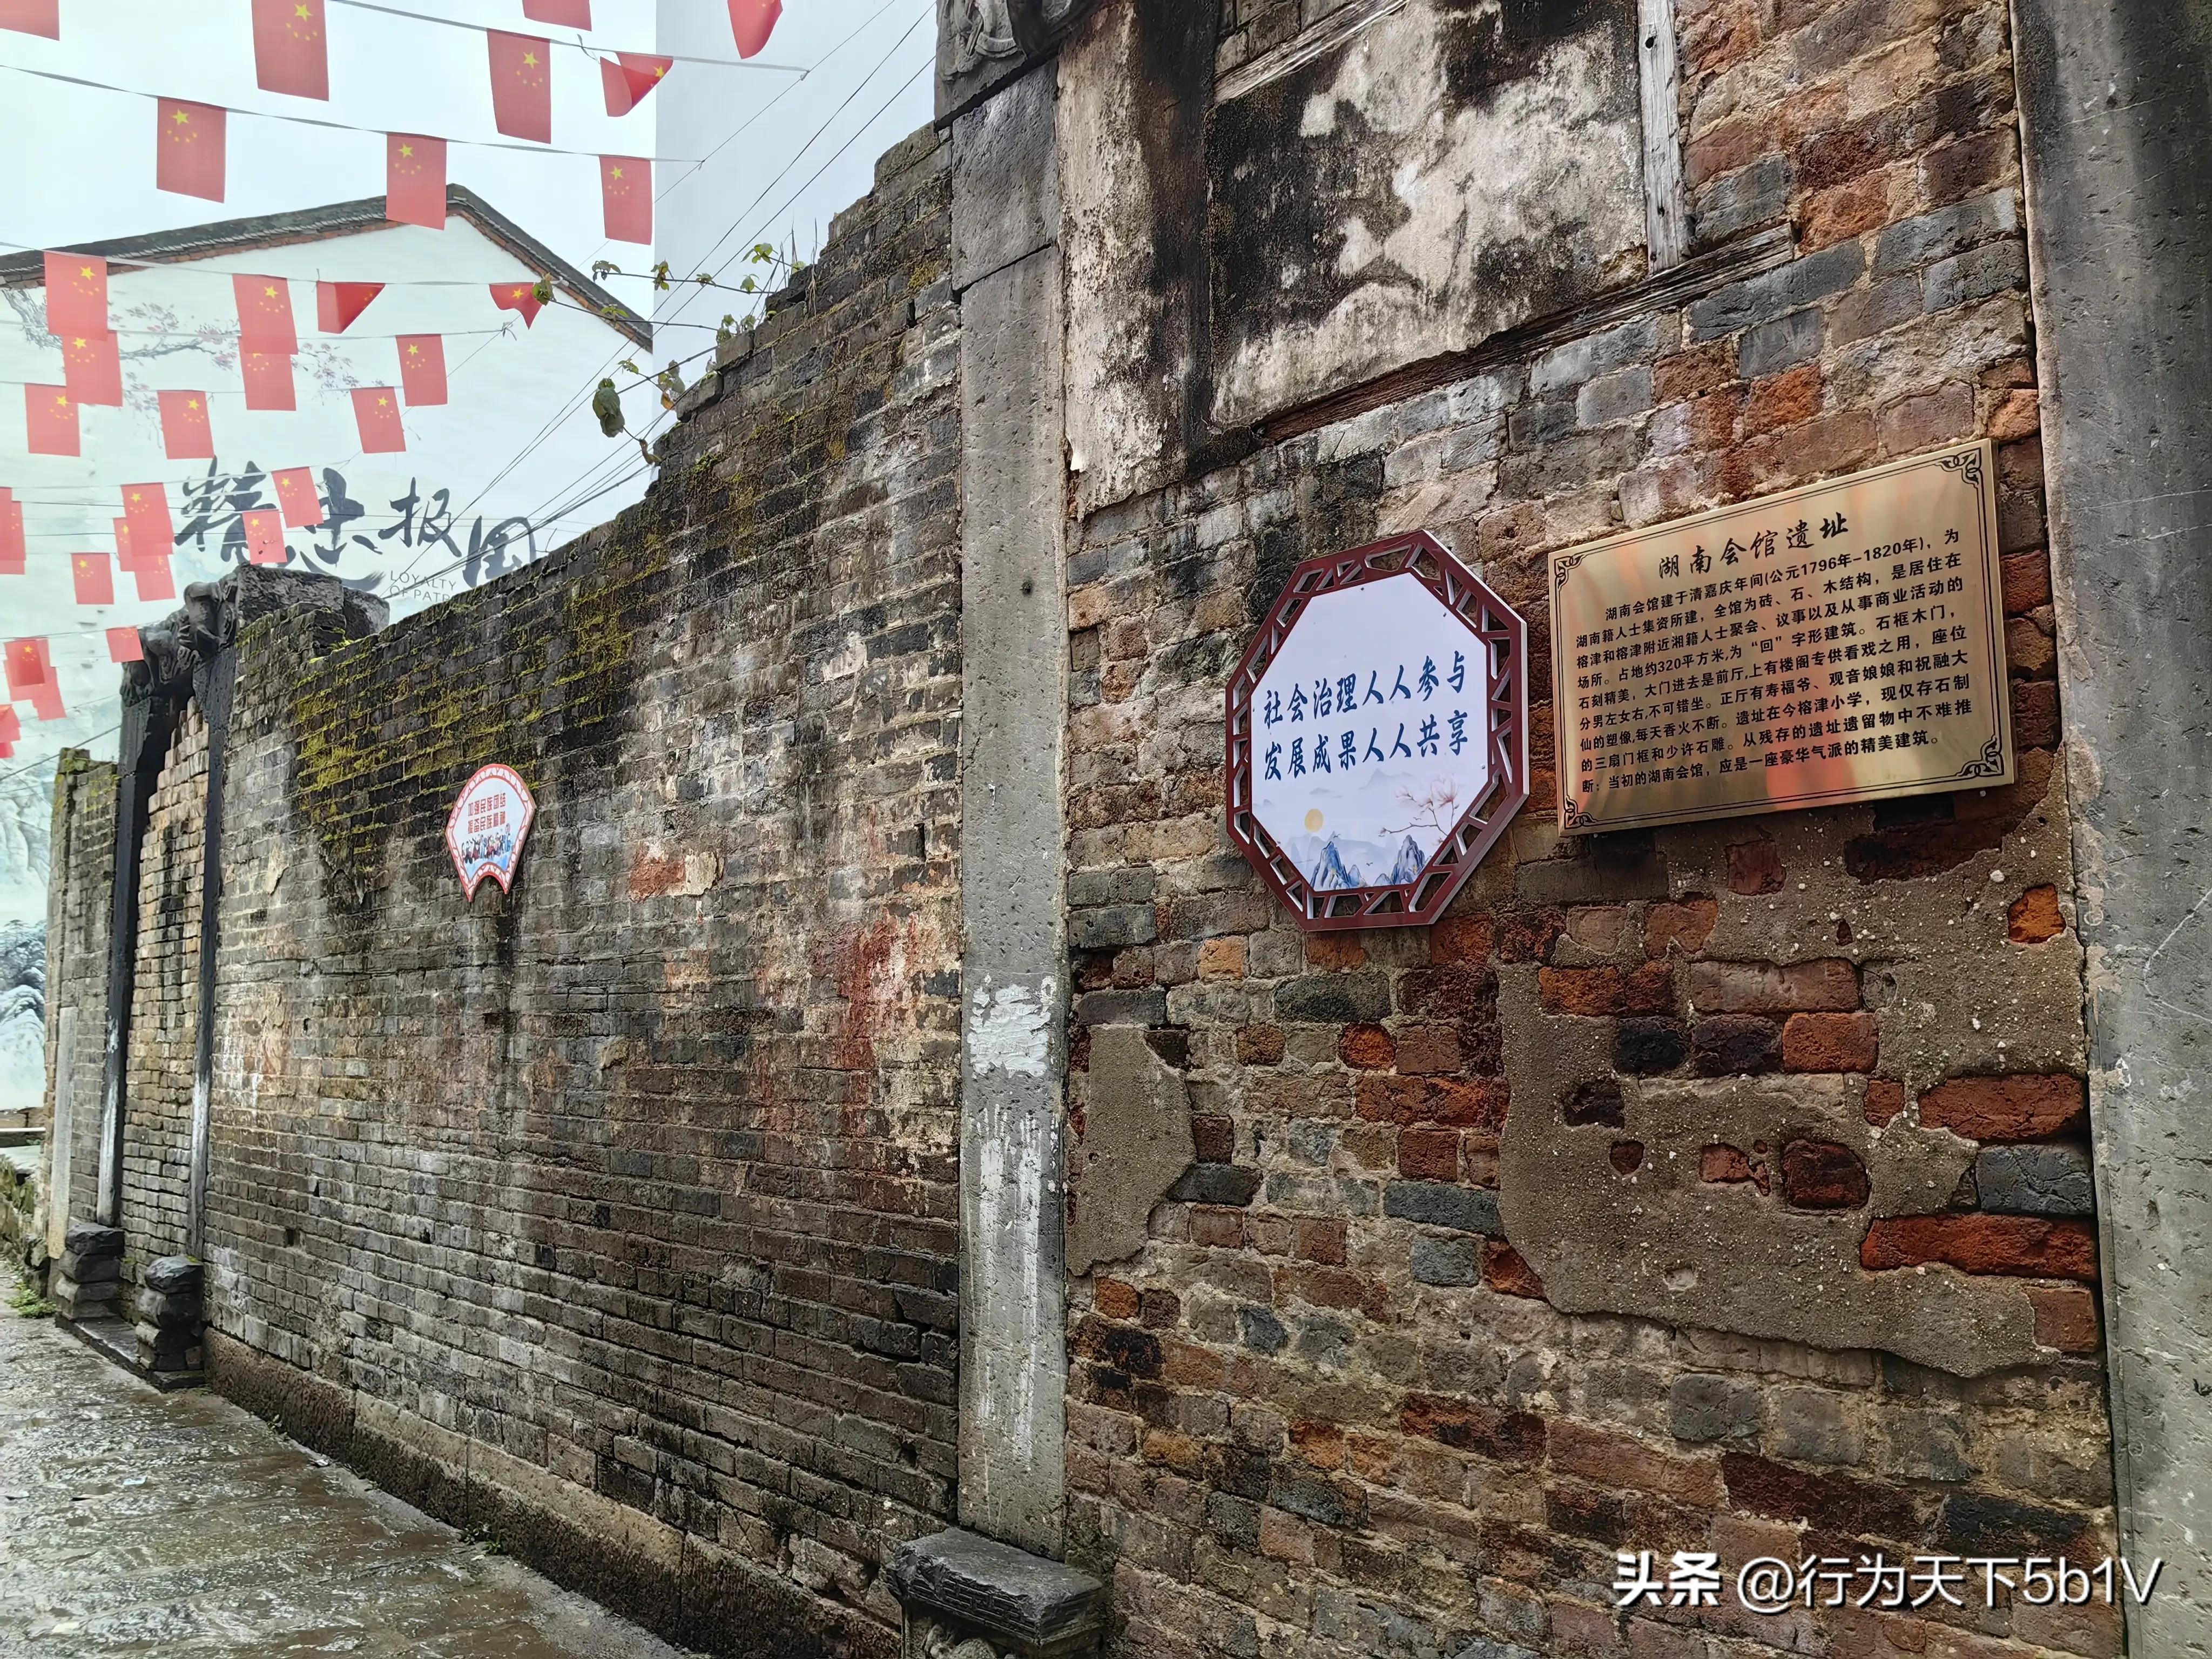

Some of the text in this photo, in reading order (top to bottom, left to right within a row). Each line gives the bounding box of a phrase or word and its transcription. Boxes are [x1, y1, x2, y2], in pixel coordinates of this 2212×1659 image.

[1658, 511, 1849, 579] 湖南会馆遗址
[390, 570, 456, 591] LOYALTY
[390, 585, 408, 597] OF
[1576, 576, 1963, 670] 榕津和榕津附近湘籍人士聚会、议事以及从事商业活动的
[1264, 651, 1464, 729] 社会治理人人参与
[1265, 710, 1467, 780] 发展成果人人共享
[1581, 698, 1972, 773] 的三扇门框和少许石雕。从残存的遗址遗留物中不难推
